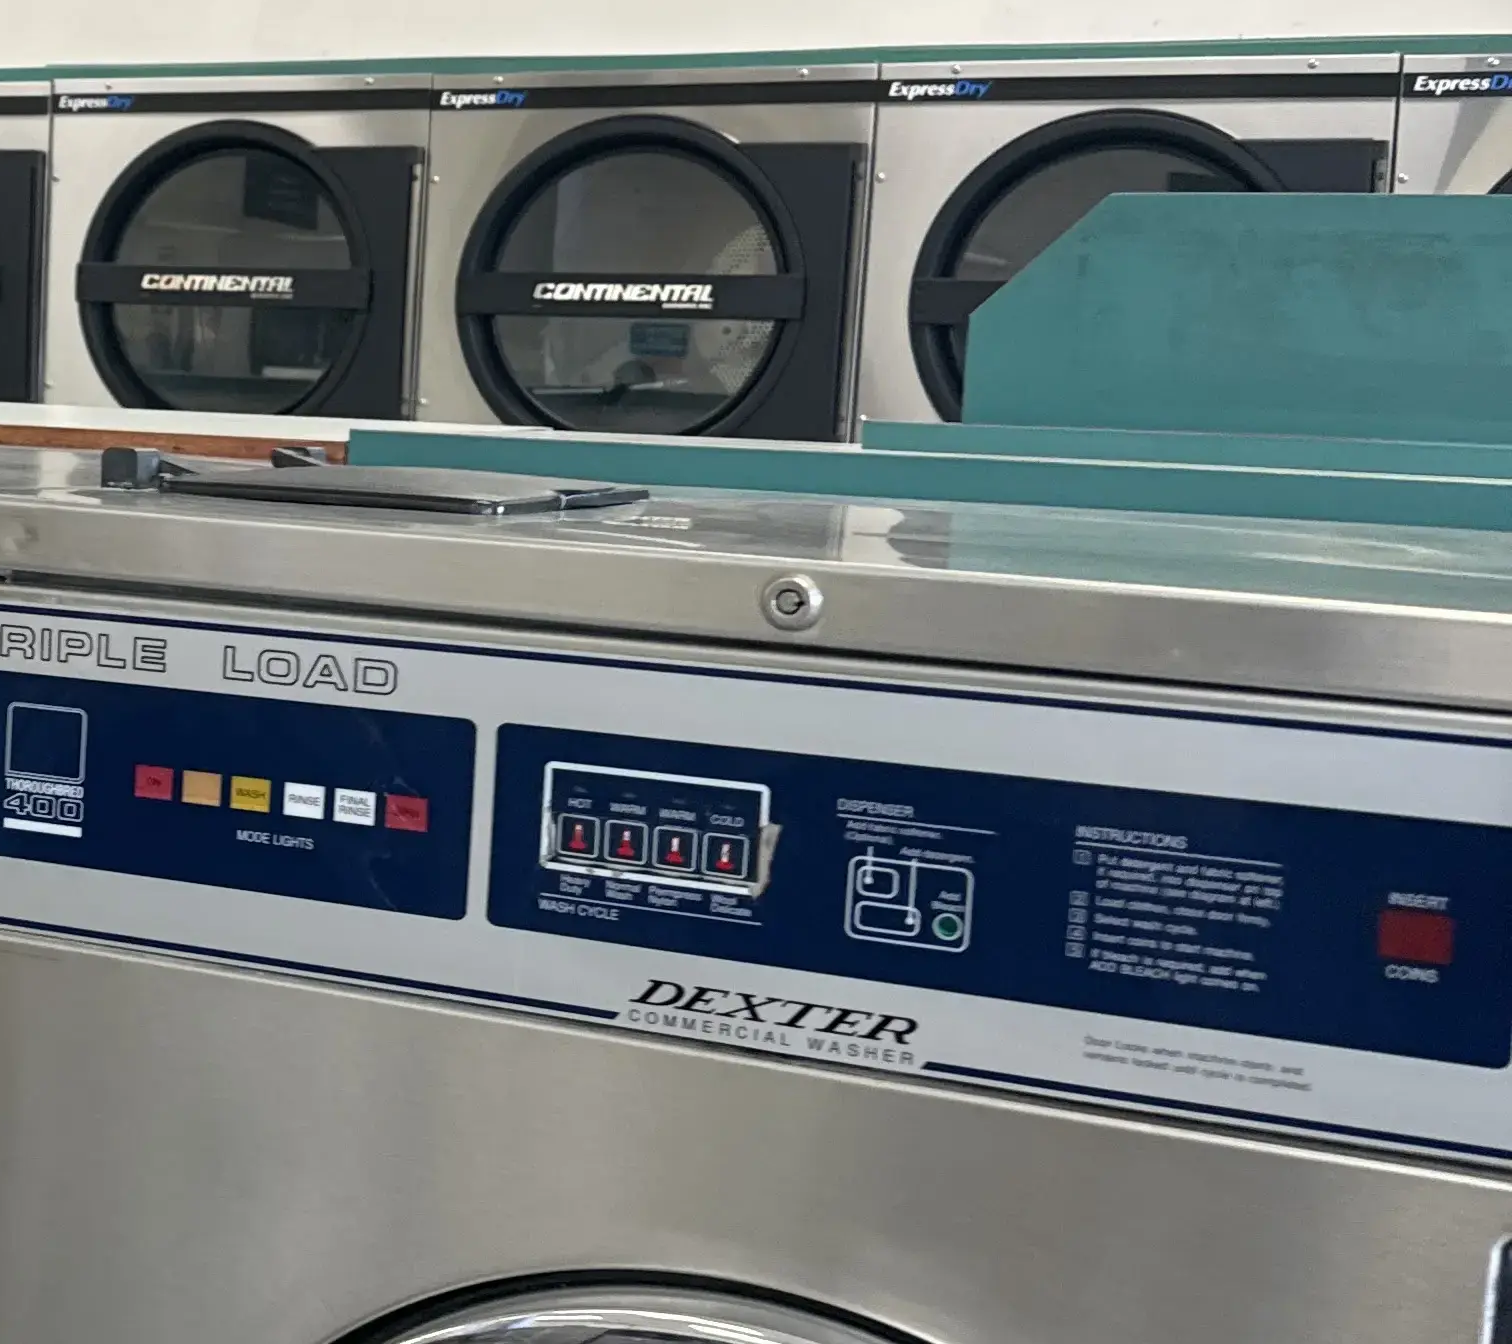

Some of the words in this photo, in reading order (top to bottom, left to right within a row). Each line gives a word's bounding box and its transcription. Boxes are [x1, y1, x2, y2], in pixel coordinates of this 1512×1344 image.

[440, 89, 527, 108] ExpressDry
[888, 80, 992, 100] ExpressDry
[58, 95, 134, 111] ExpressDry
[140, 273, 294, 292] CONTINENTAL
[532, 282, 715, 302] CONTINENTAL
[223, 645, 398, 695] LOAD
[3, 792, 84, 823] 400
[288, 794, 321, 808] RINSE
[236, 829, 271, 846] MODE
[272, 833, 315, 851] LIGHTS
[1387, 892, 1449, 910] INSERT
[630, 979, 920, 1045] DEXTER
[628, 1008, 793, 1048] COMMERCIAL
[806, 1036, 916, 1066] WASHER
